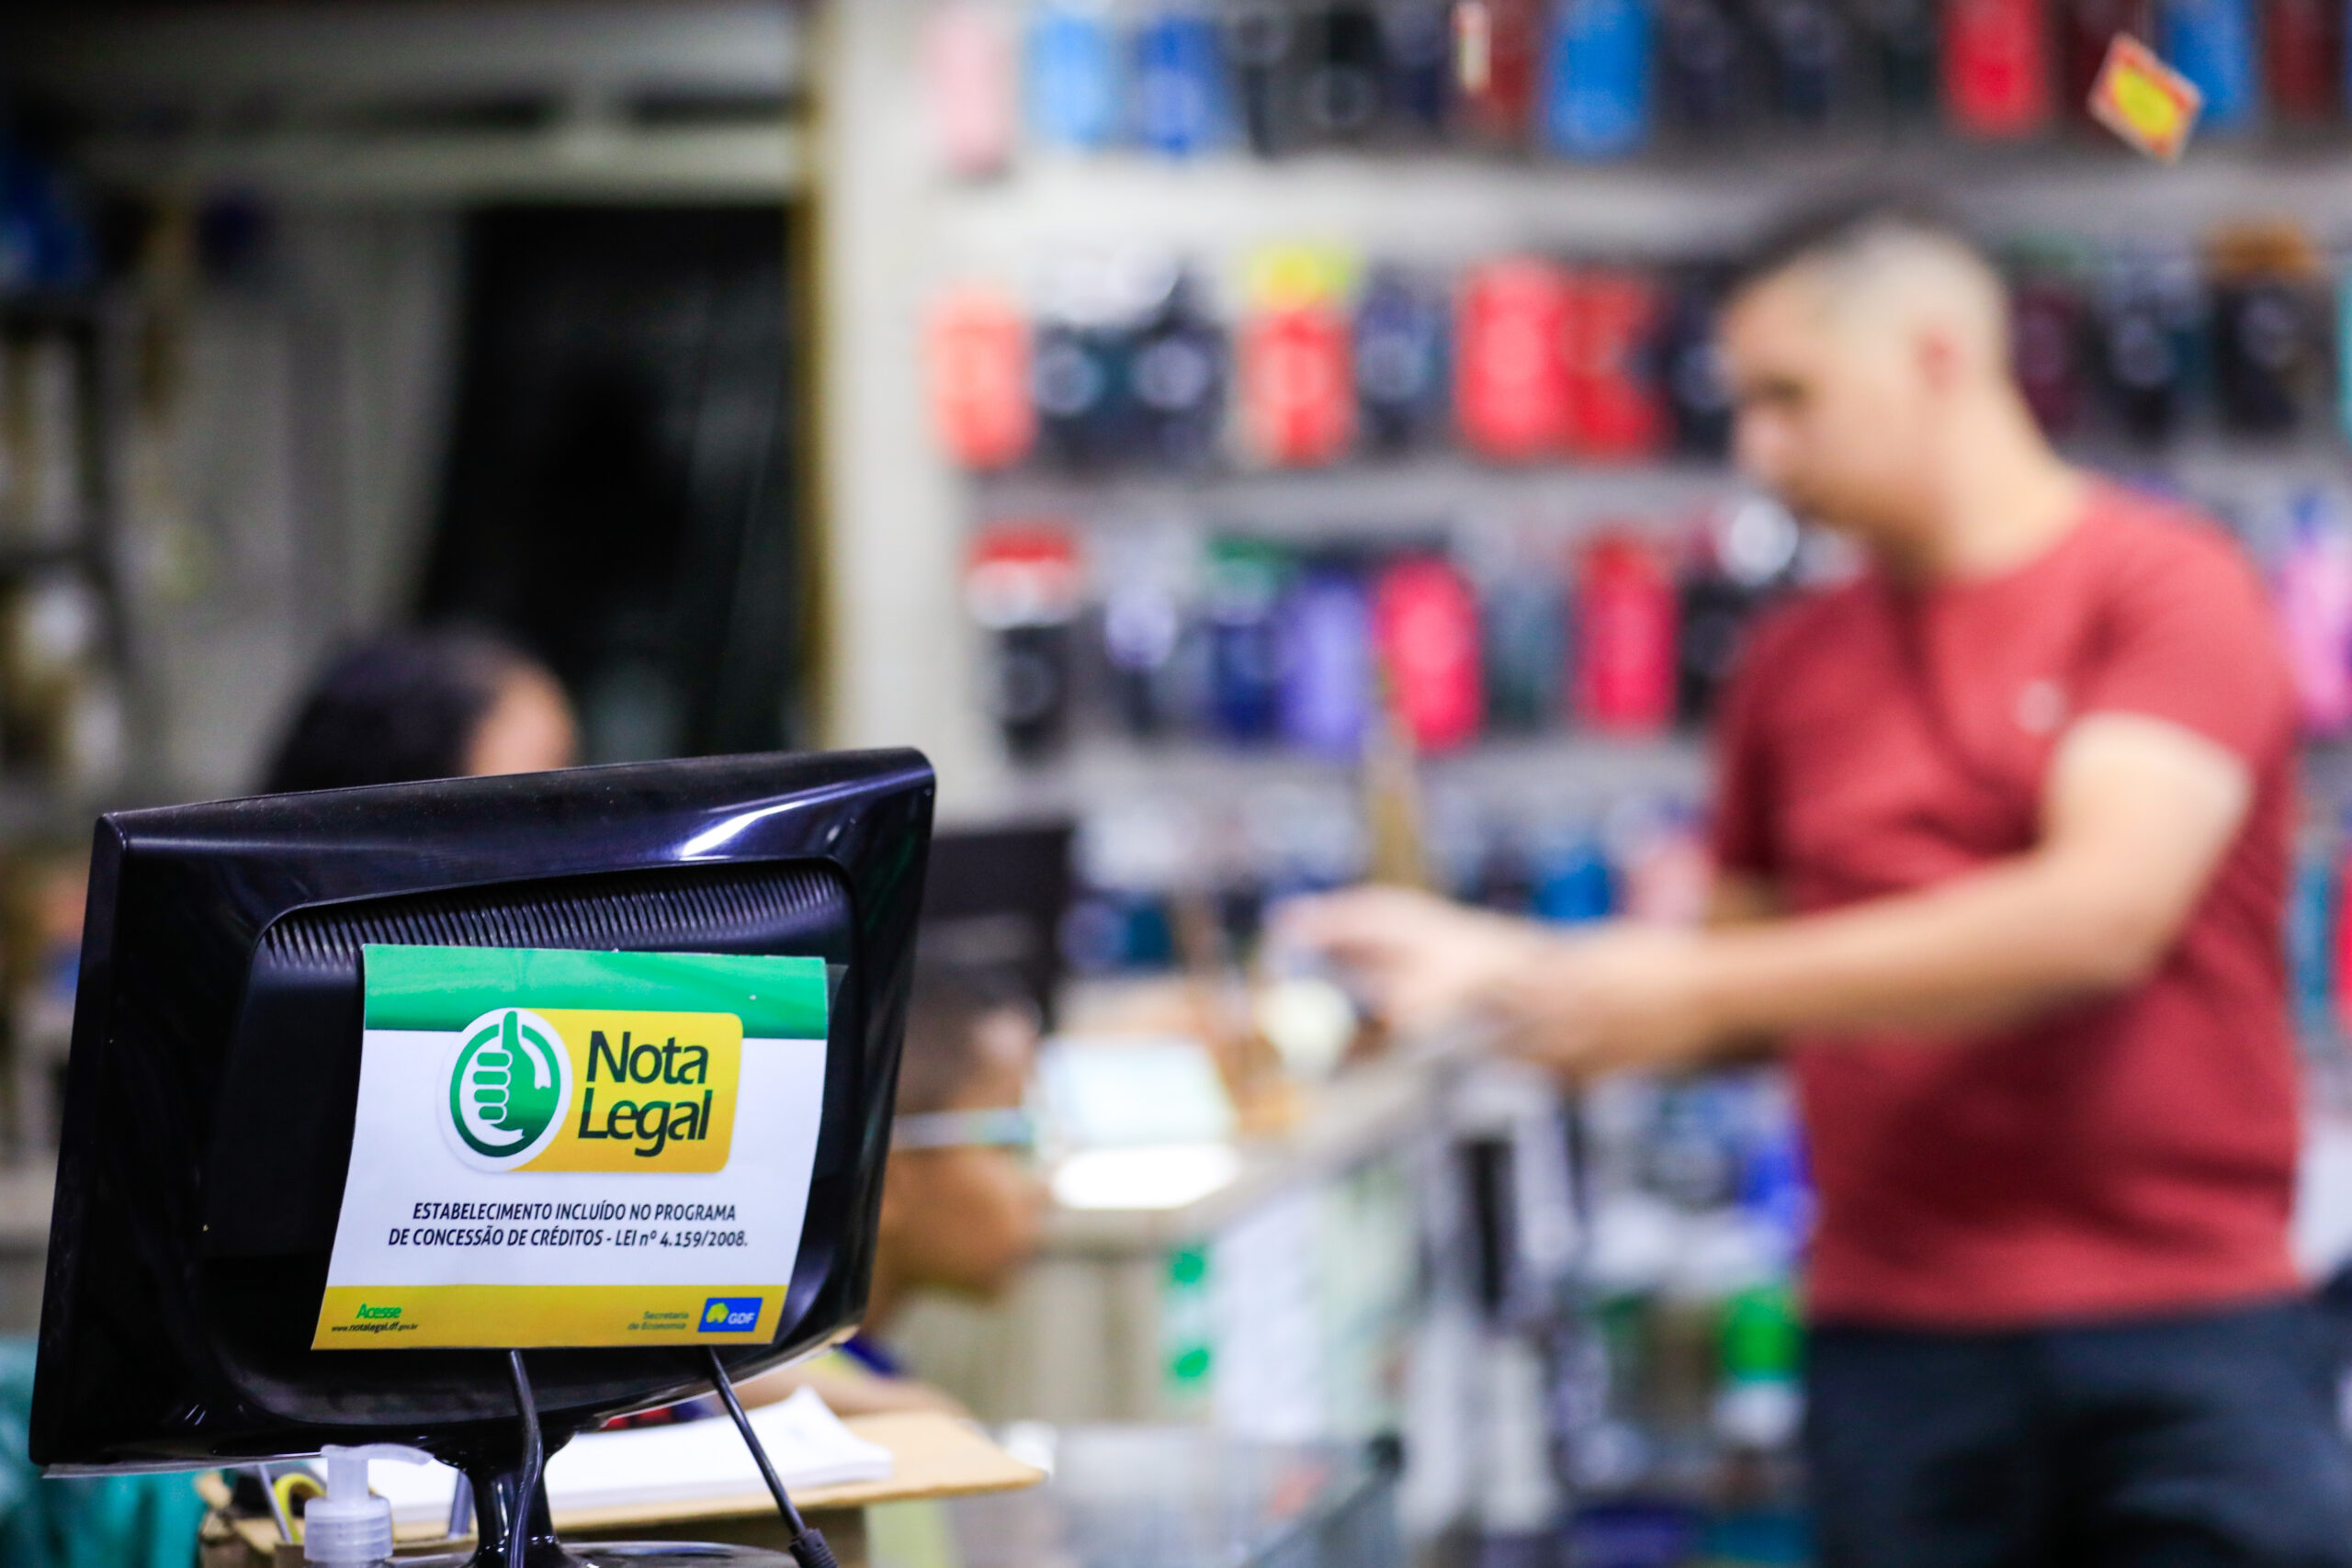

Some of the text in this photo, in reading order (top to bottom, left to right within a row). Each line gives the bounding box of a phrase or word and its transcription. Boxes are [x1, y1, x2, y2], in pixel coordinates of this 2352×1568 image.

[586, 1031, 709, 1085] Nota
[578, 1088, 713, 1157] Legal
[413, 1201, 736, 1222] ESTABELECIMENTO INCLUÍDO NO PROGRAMA
[389, 1228, 410, 1247] DE
[413, 1225, 503, 1247] CONCESSÃO
[507, 1229, 528, 1247] DE
[531, 1225, 604, 1247] CRÉDITOS
[615, 1229, 638, 1247] LEI
[659, 1231, 749, 1248] 4.159/2008.
[356, 1303, 401, 1319] Acesse
[643, 1311, 689, 1320] Secretaria
[727, 1312, 756, 1325] GDF
[641, 1321, 686, 1331] Economia
